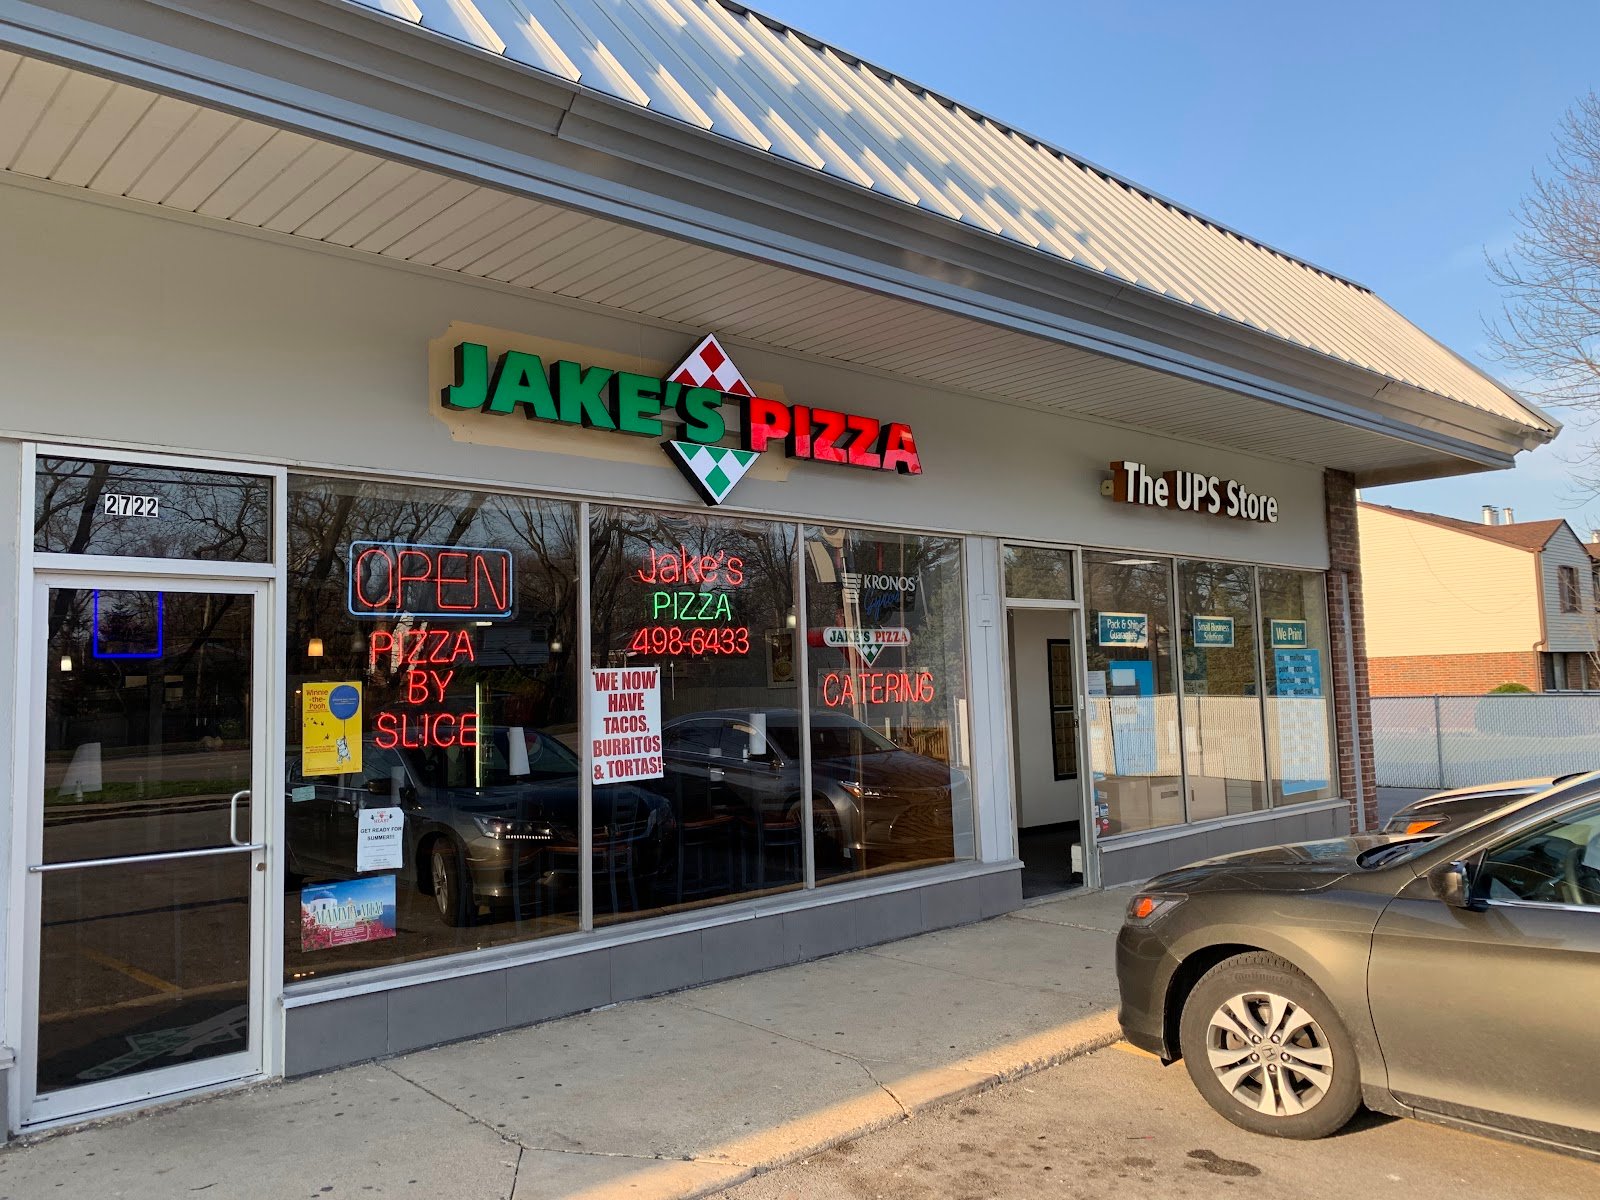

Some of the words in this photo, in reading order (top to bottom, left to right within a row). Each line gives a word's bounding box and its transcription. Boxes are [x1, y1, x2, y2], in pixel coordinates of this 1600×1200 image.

[442, 342, 726, 443] JAKE'S
[746, 396, 923, 475] PIZZA
[1123, 461, 1169, 507] The
[1176, 470, 1221, 514] UPS
[1226, 480, 1279, 523] Store
[106, 495, 157, 516] 2722
[637, 545, 745, 586] Jake's
[356, 549, 506, 610] OPEN
[653, 591, 732, 621] PIZZA
[1107, 618, 1121, 629] Pack
[1121, 619, 1127, 630] &
[1197, 622, 1211, 632] Small
[1210, 622, 1230, 632] Business
[1275, 627, 1287, 641] We
[1287, 627, 1303, 641] Print
[632, 627, 750, 655] 498-6433
[829, 630, 871, 642] JAKE'S
[874, 630, 908, 642] PIZZA
[1203, 631, 1224, 642] Solutions
[370, 630, 475, 665] PIZZA
[409, 670, 454, 704] BY
[595, 673, 618, 691] WE
[621, 671, 657, 690] NOW
[823, 672, 935, 708] CATERING
[608, 692, 645, 713] HAVE
[375, 713, 480, 748] SLICE
[603, 715, 650, 735] TACOS,
[593, 735, 661, 758] BURRITOS
[594, 765, 604, 779] &
[606, 757, 662, 778] TORTAS!
[316, 904, 358, 924] MAMMA
